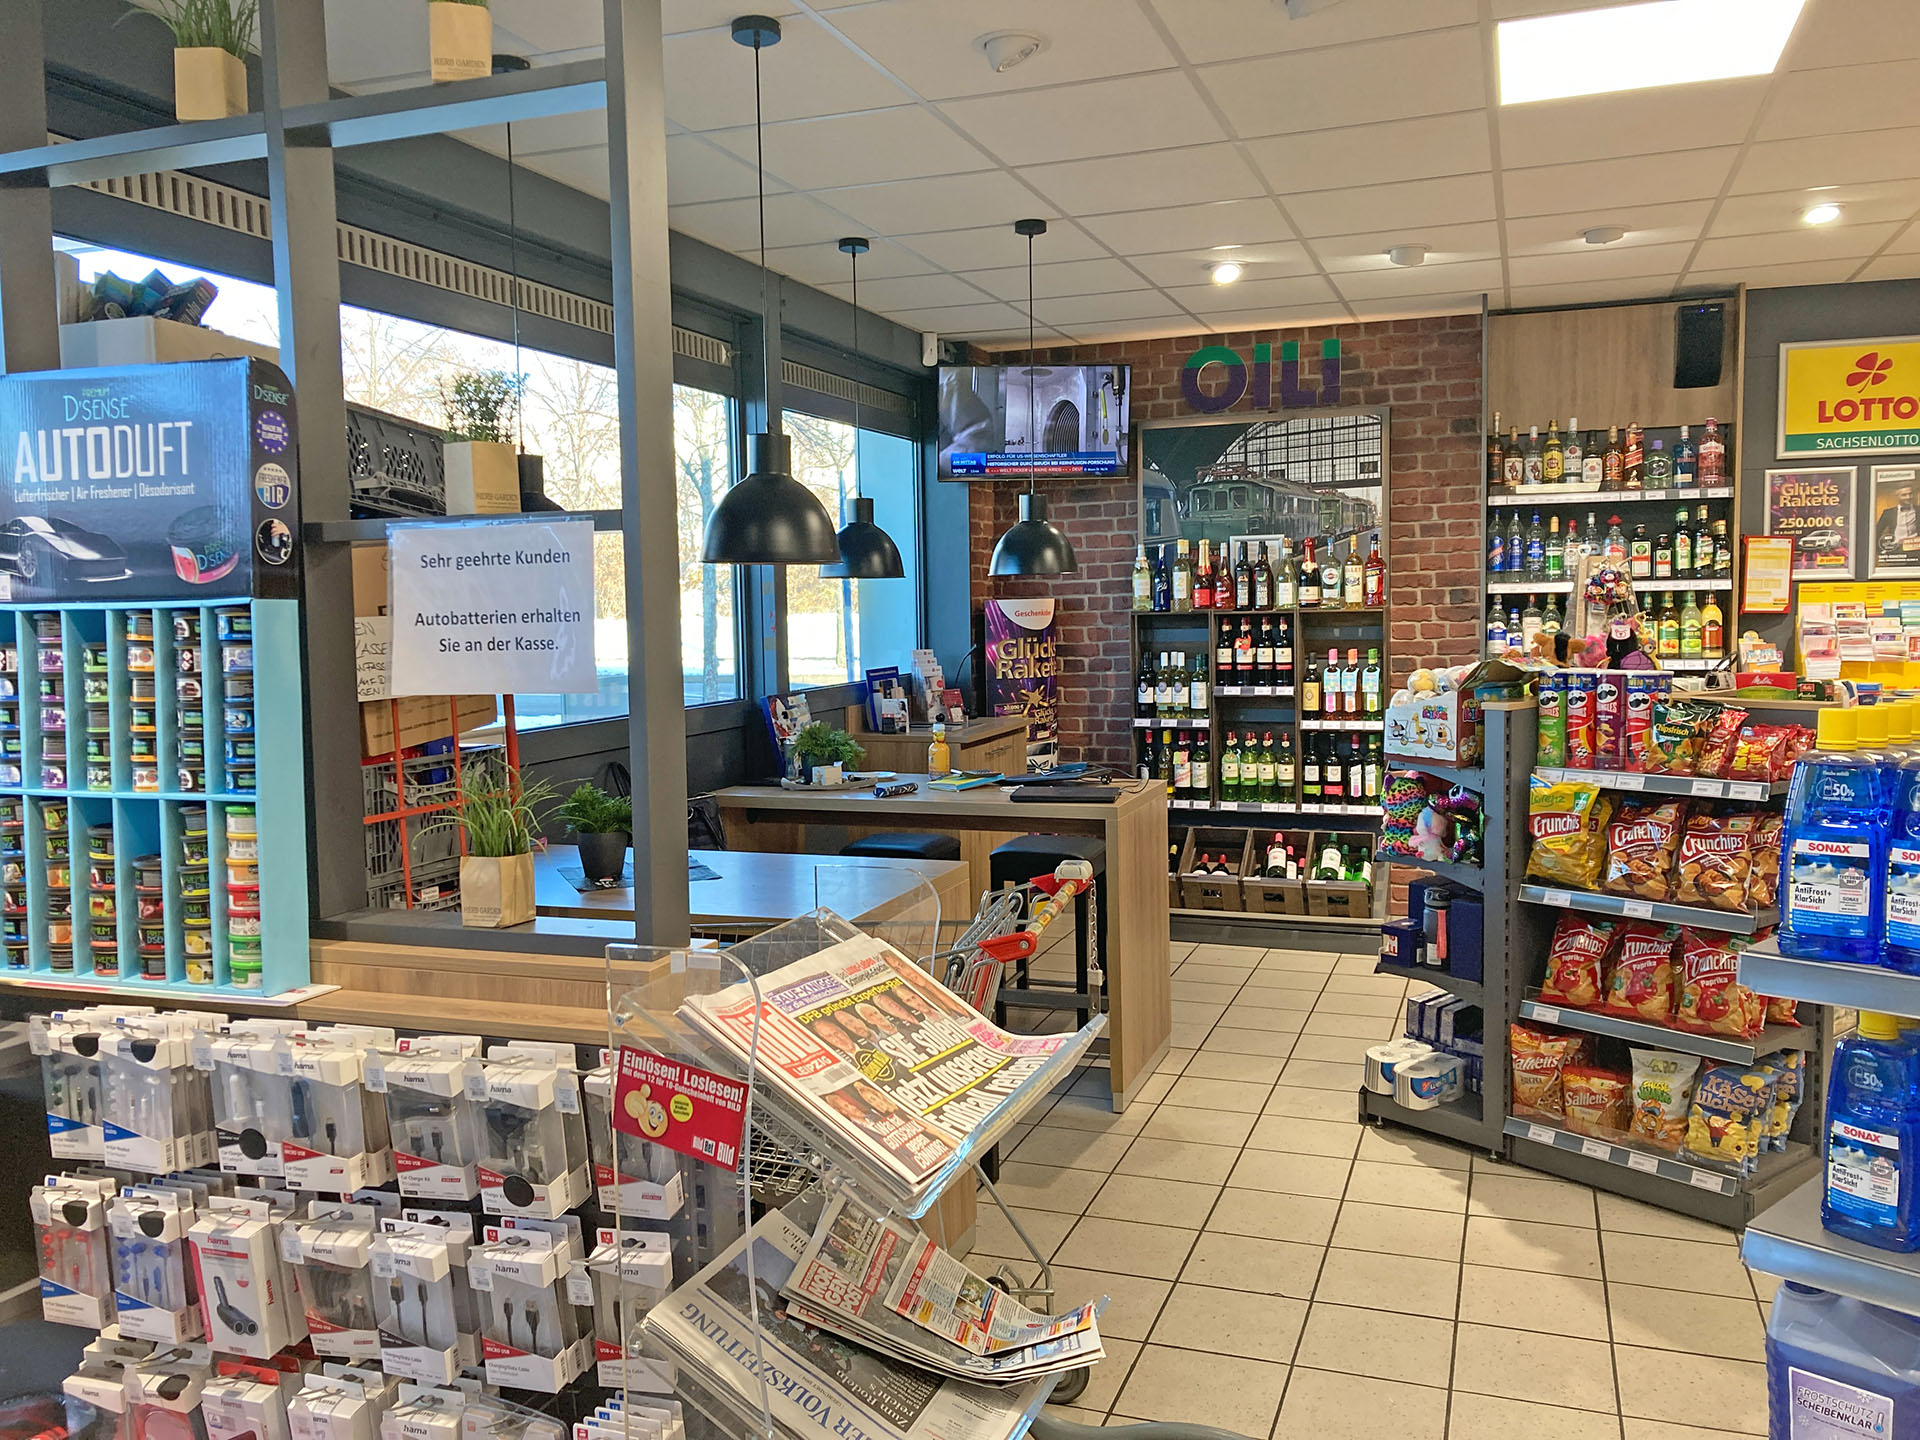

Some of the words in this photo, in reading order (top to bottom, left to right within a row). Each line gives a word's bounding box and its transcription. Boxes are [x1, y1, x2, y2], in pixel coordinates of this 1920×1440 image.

[1818, 396, 1919, 423] LOTTO
[1816, 434, 1919, 449] SACHSENLOTTO
[14, 421, 193, 483] AUTODUFT
[14, 489, 69, 503] Lufterfrischer
[77, 487, 88, 499] Air
[90, 485, 132, 499] Freshener
[139, 482, 194, 498] Désodorisant
[264, 488, 284, 504] AIR
[1782, 482, 1839, 496] Glücks
[1780, 493, 1840, 507] Rakete
[1779, 517, 1832, 528] 250.000
[1835, 516, 1844, 526] €
[421, 554, 452, 569] Sehr
[456, 552, 511, 570] geehrte
[515, 548, 571, 565] Kunden
[415, 611, 516, 626] Autobatterien
[521, 608, 581, 624] erhalten
[439, 638, 460, 652] Sie
[465, 640, 482, 651] an
[487, 637, 511, 651] der
[515, 636, 559, 651] Kasse.
[1656, 723, 1689, 735] Chipsfrisch
[1832, 784, 1855, 797] 50%
[1533, 816, 1580, 837] Crunchips
[1615, 823, 1666, 846] Crunchips
[1682, 834, 1743, 857] Crunchips
[1808, 843, 1850, 854] SONAX
[1794, 895, 1825, 905] KlarSicht
[1795, 885, 1832, 897] AntiFrost+
[1891, 905, 1917, 915] KlarSicht
[1632, 960, 1657, 970] Paprika
[1701, 978, 1729, 987] Paprika
[799, 1009, 823, 1025] DFB
[821, 995, 854, 1016] gründet
[853, 977, 904, 1004] Experten-Rat
[878, 1031, 923, 1069] SIE
[913, 1015, 972, 1055] sollen
[226, 1050, 247, 1060] hama
[294, 1061, 314, 1071] hama
[792, 1055, 832, 1077] LEIPZIG
[403, 1074, 425, 1084] hama
[623, 1050, 680, 1081] Einlösen!
[683, 1069, 744, 1103] Loslesen!
[882, 1069, 937, 1112] jetzt
[931, 1045, 1009, 1094] unseren
[490, 1084, 512, 1094] hama
[622, 1066, 632, 1077] Mit
[633, 1070, 646, 1081] dem
[648, 1074, 656, 1083] 12
[656, 1076, 665, 1086] für
[715, 1097, 727, 1107] von
[727, 1100, 742, 1113] BILD
[1565, 1092, 1609, 1106] Saltletts
[924, 1085, 1000, 1141] Fußball
[882, 1120, 926, 1150] GOTTSCHALK
[904, 1134, 931, 1154] gegen
[1843, 1126, 1880, 1144] SONAX
[716, 1141, 735, 1166] Bild
[913, 1140, 948, 1168] CONNOR?
[1831, 1172, 1858, 1188] KlarSicht
[1832, 1165, 1863, 1182] AntiFrost+
[206, 1236, 230, 1246] hama
[495, 1264, 520, 1275] hama
[806, 1266, 835, 1298] MOR
[824, 1272, 850, 1306] GEN
[840, 1282, 864, 1314] POST
[680, 1302, 834, 1429] VOLKSZEITUNG
[836, 1371, 878, 1405] Rodeln
[871, 1383, 914, 1417] reicht's
[1796, 1386, 1874, 1420] FROSTSCHUTZ
[880, 1405, 908, 1428] Zum
[1797, 1397, 1873, 1430] SCHEIBENKLAR
[403, 1425, 428, 1437] hama
